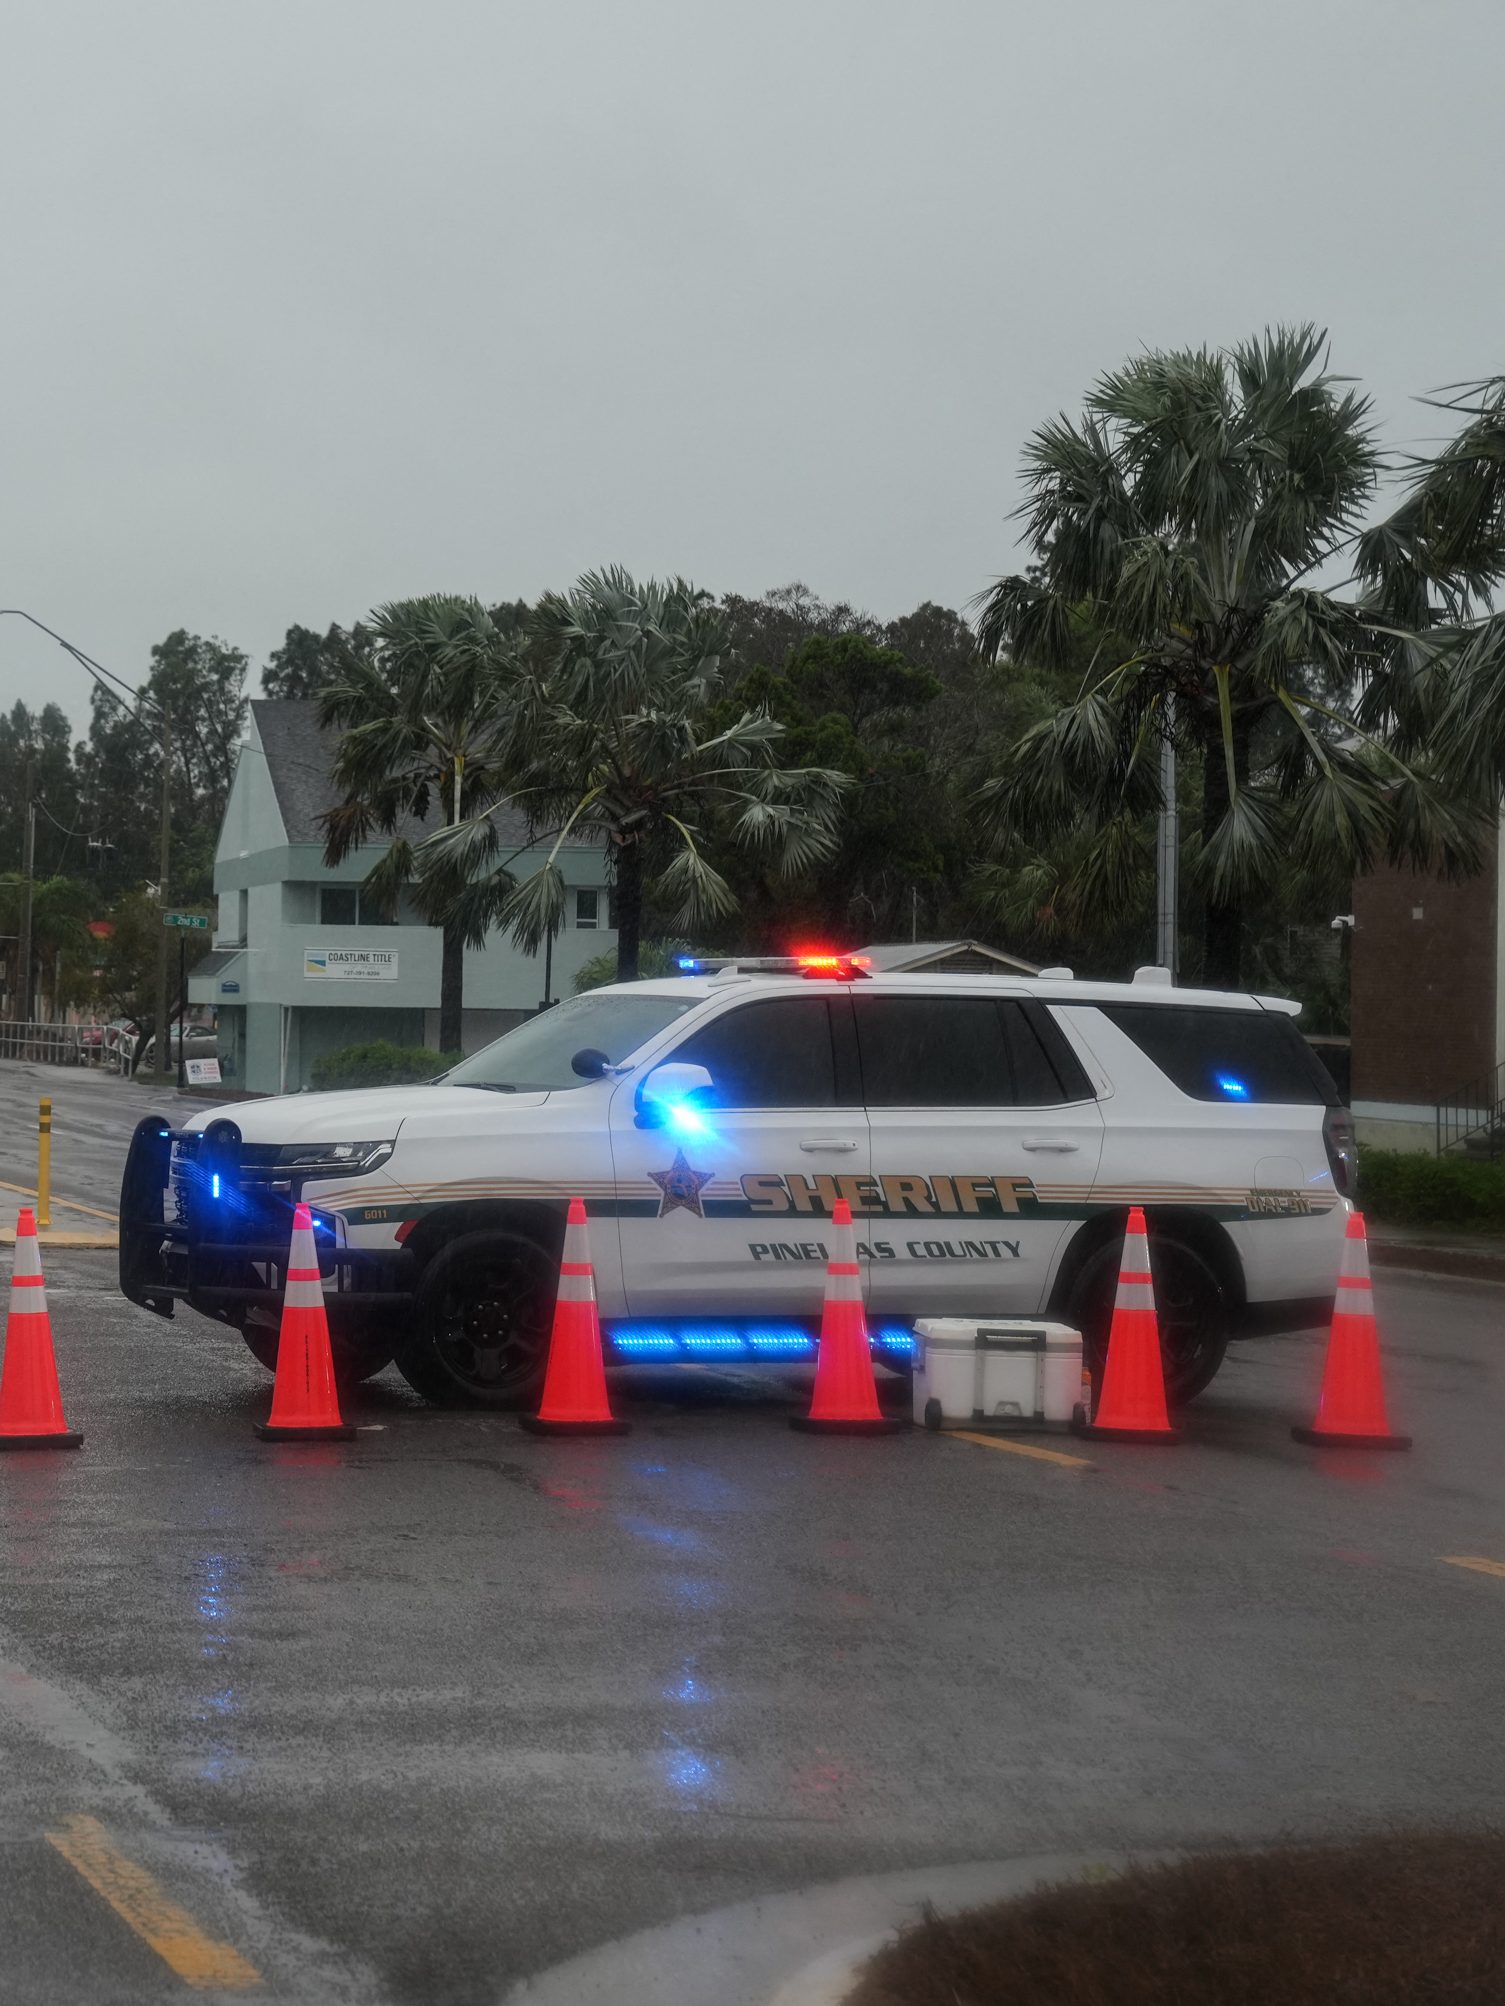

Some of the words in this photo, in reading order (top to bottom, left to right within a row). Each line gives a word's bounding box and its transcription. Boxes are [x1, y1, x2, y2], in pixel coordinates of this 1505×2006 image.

[177, 916, 191, 926] 2nd
[191, 917, 200, 928] St
[328, 952, 370, 963] COASTLINE
[372, 953, 392, 963] TITLE
[740, 1174, 1035, 1213] SHERIFF
[364, 1209, 388, 1220] 6011
[748, 1242, 896, 1261] PINELAS
[906, 1240, 1021, 1258] COUNTY
